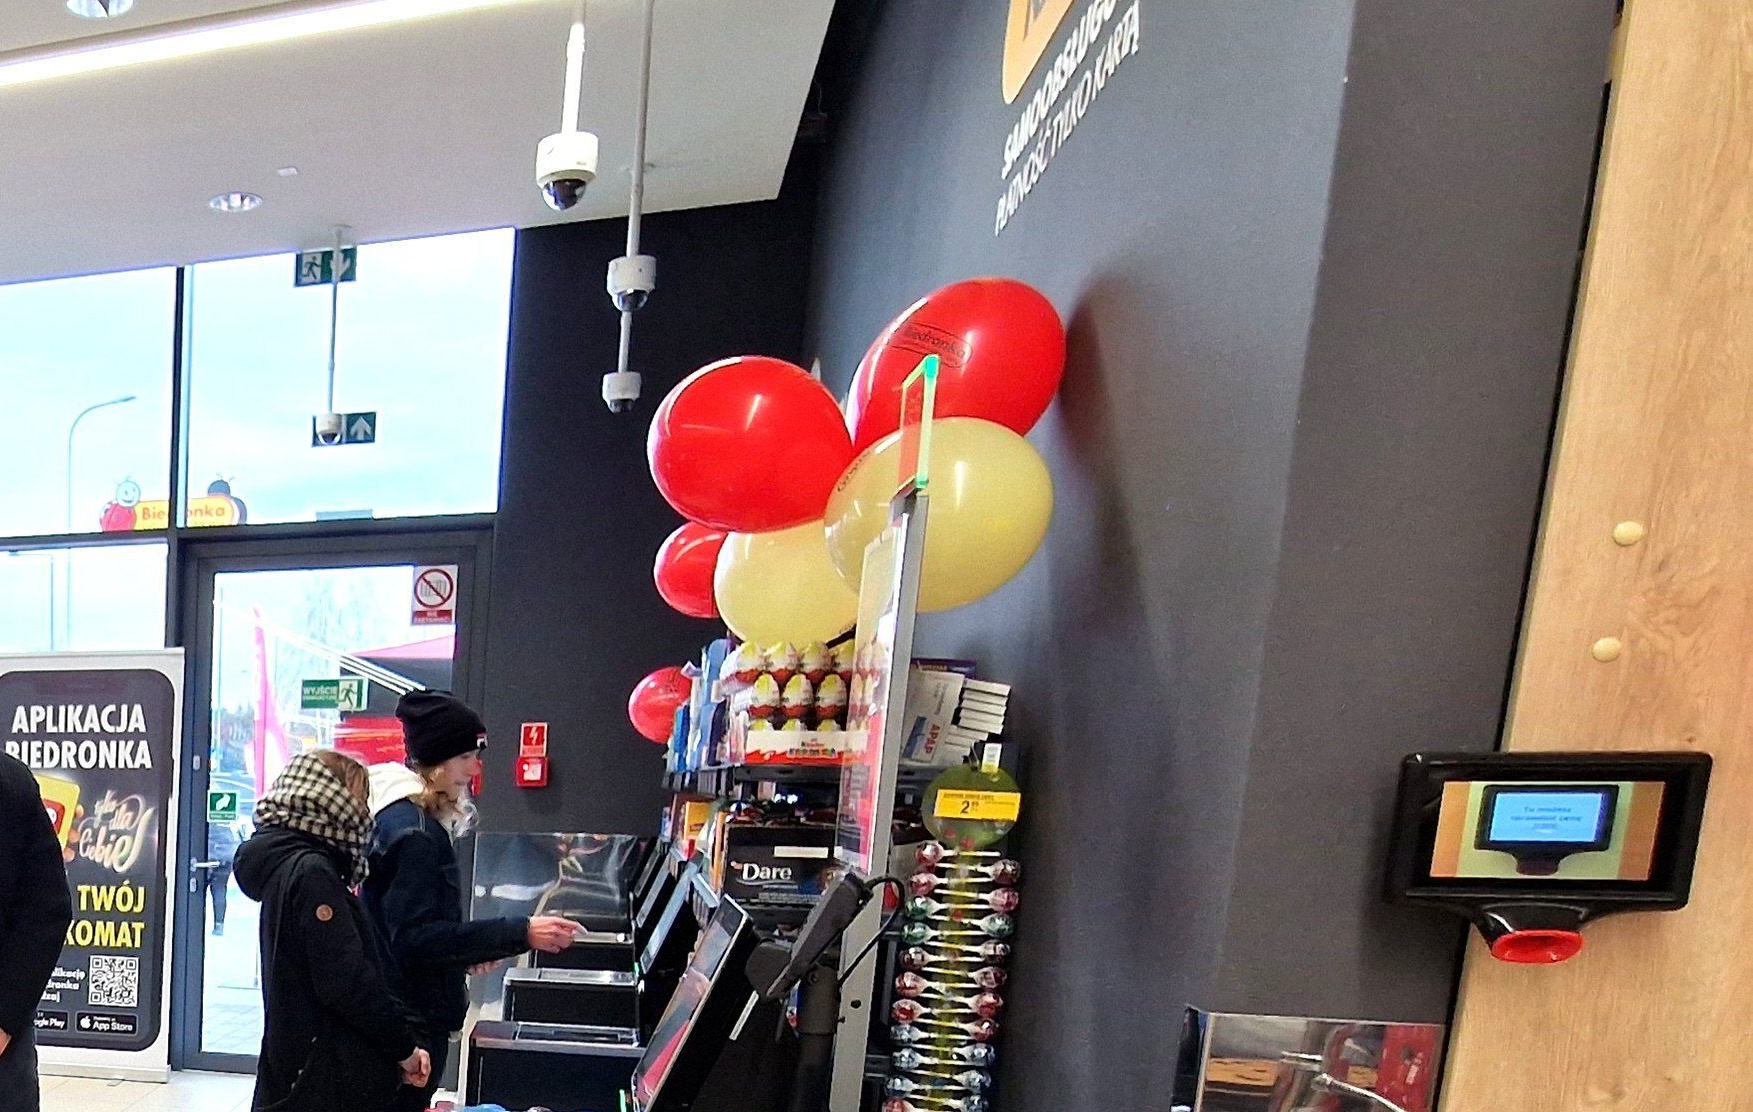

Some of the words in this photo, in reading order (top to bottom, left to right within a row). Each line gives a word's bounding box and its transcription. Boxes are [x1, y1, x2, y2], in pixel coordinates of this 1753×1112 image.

[1051, 70, 1092, 158] TYLKO
[303, 685, 338, 695] WYJŚCIE
[11, 703, 147, 734] APLIKACJA
[924, 723, 941, 755] APAP
[5, 740, 153, 769] BIEDRONKA
[741, 863, 792, 881] Dare
[77, 879, 145, 913] TWÓJ
[49, 1017, 66, 1029] Play
[92, 1021, 110, 1031] App
[111, 1021, 133, 1031] Store
